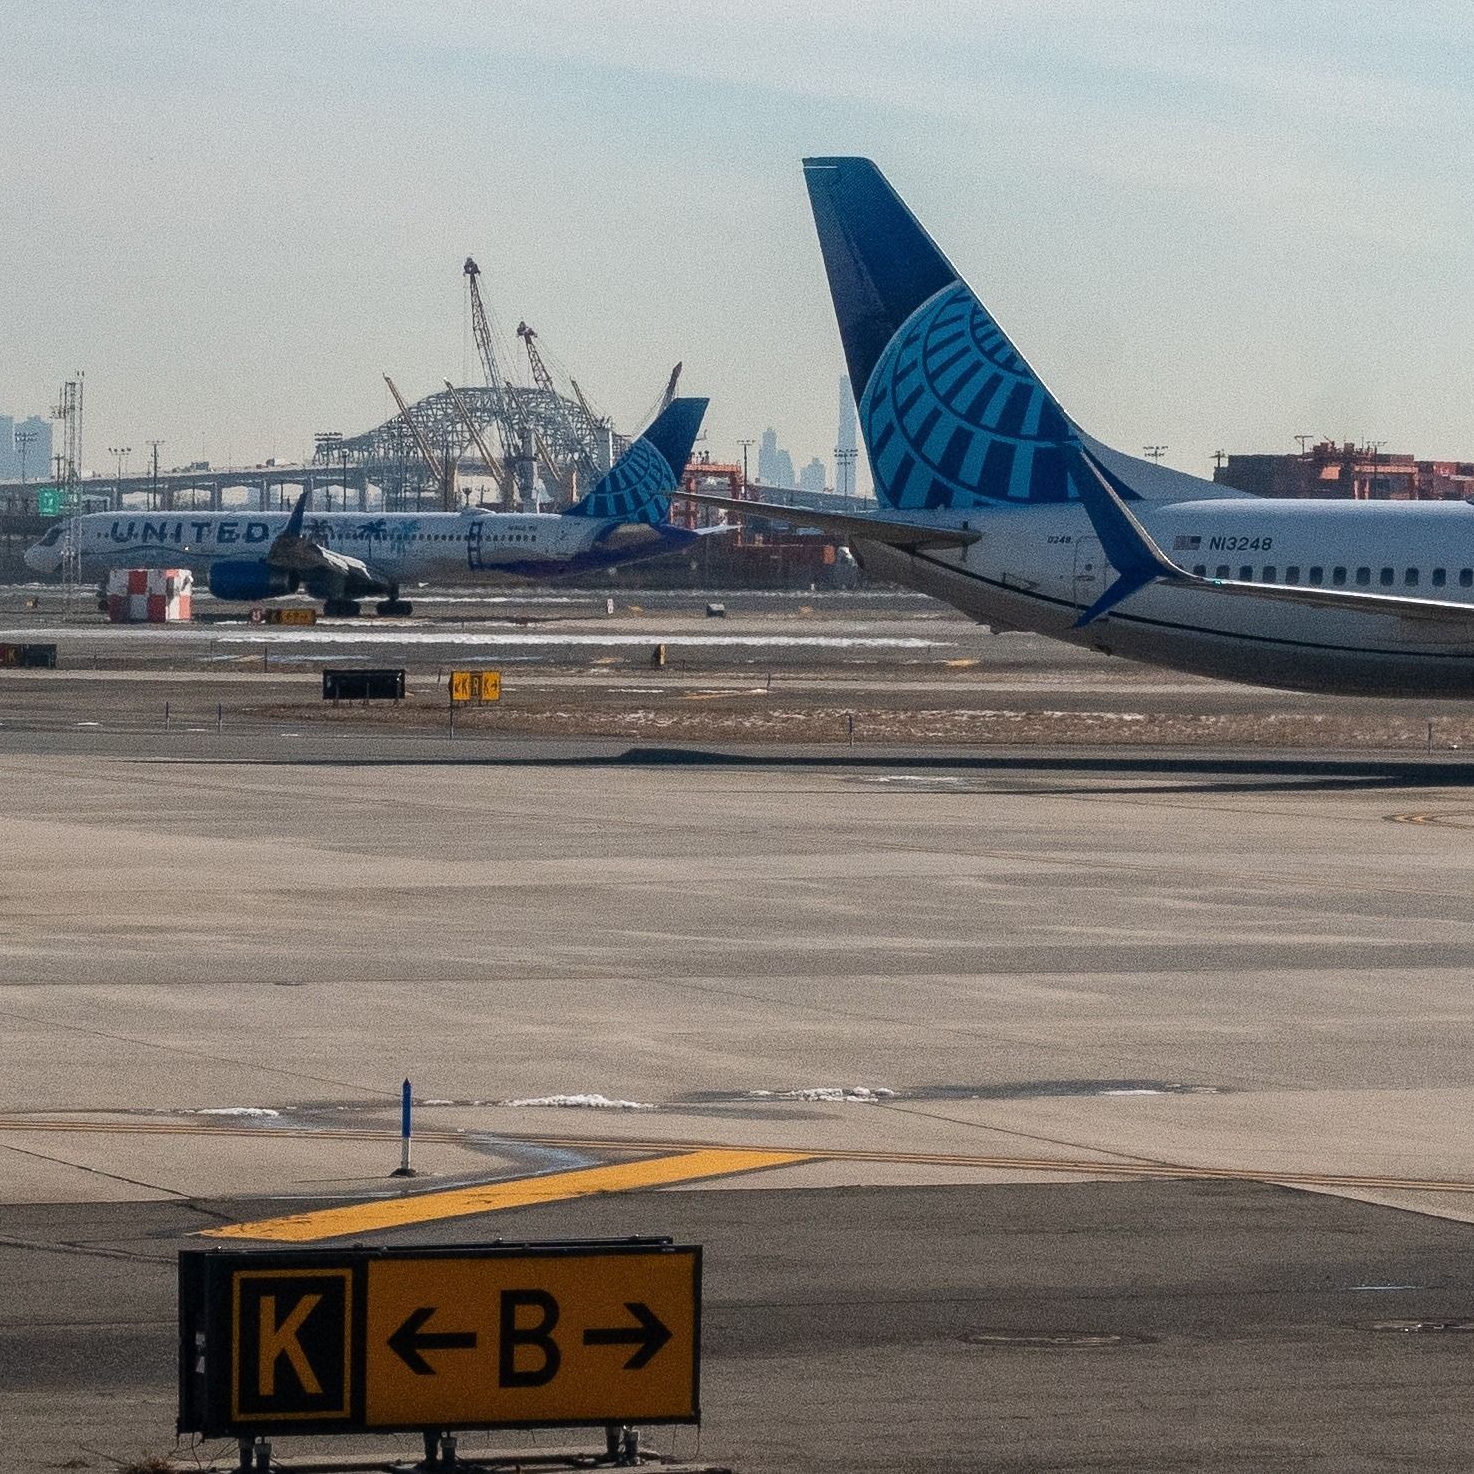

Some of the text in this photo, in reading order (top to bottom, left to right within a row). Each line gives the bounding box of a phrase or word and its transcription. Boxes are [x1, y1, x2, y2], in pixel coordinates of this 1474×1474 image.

[110, 522, 269, 543] UNITED
[1209, 536, 1273, 551] N13248
[259, 1289, 561, 1396] K B
